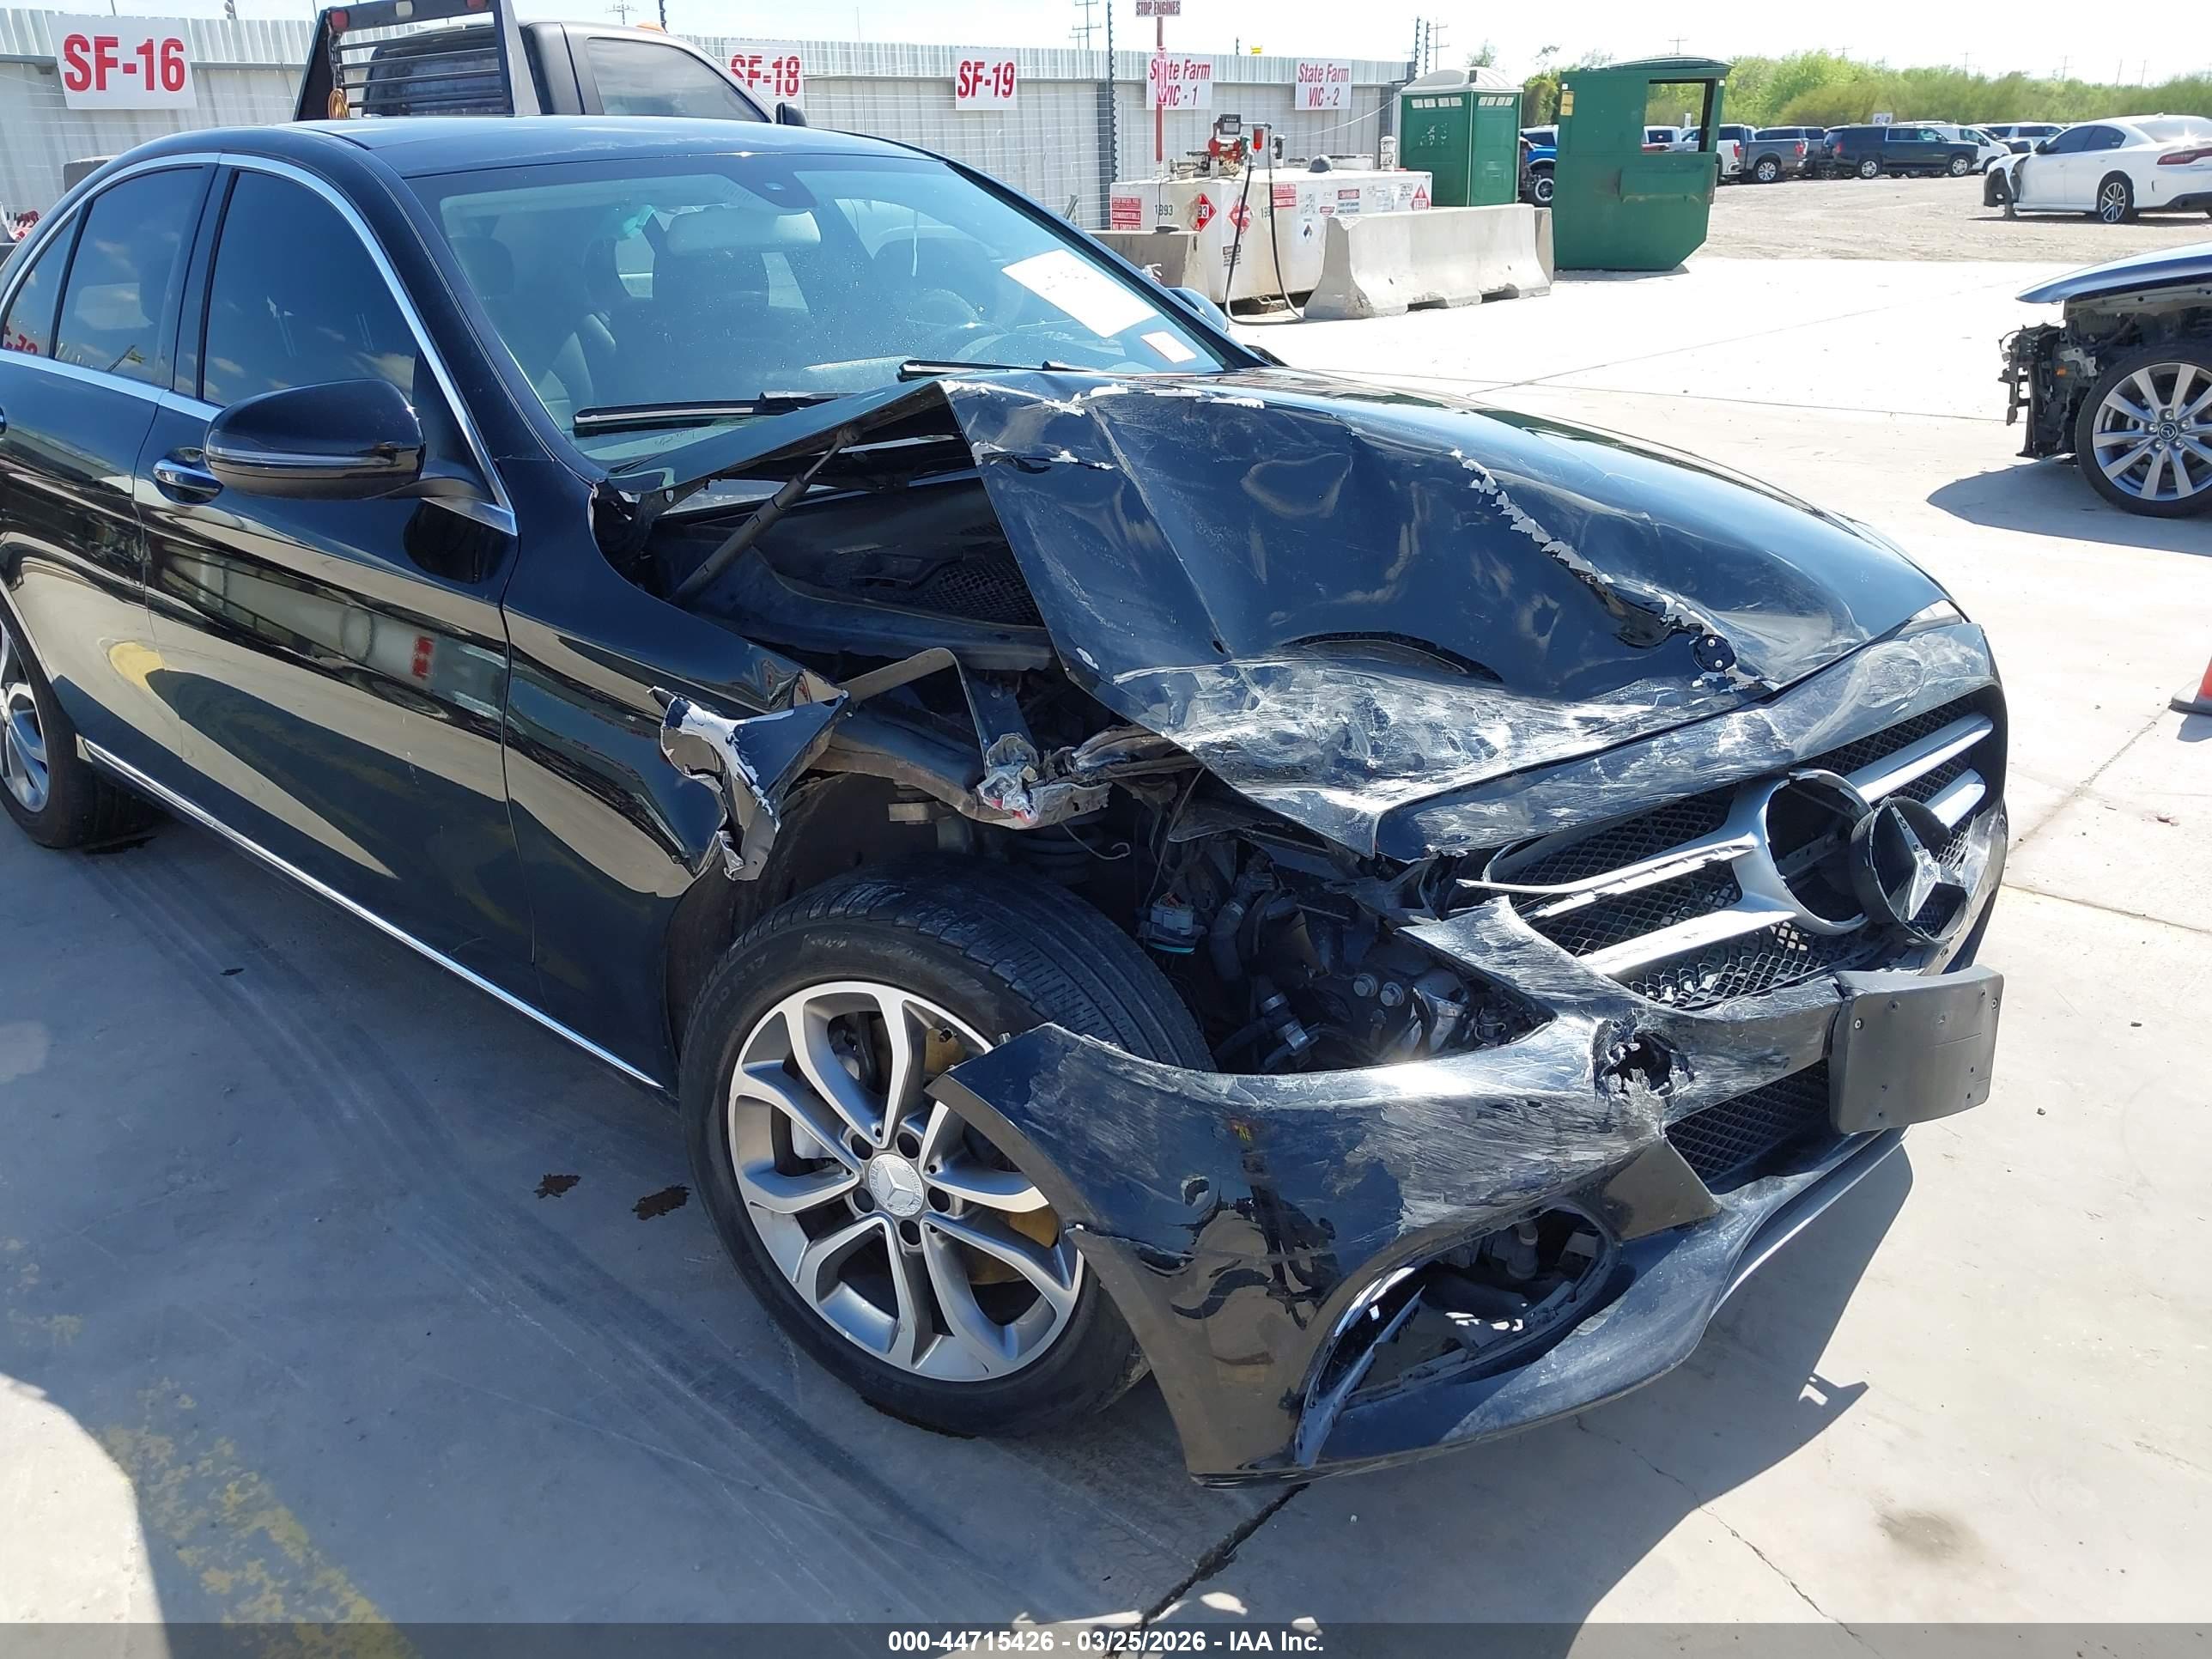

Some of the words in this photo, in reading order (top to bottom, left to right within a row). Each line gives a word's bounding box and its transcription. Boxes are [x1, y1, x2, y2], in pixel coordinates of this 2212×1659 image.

[1136, 2, 1152, 15] STOP
[1154, 1, 1181, 15] ENGINES
[64, 33, 185, 92] SF-16
[1149, 58, 1180, 81] Ste
[1182, 58, 1211, 80] Farm
[1297, 63, 1323, 82] State
[1326, 64, 1349, 82] Farm
[731, 54, 800, 97] SF-18
[957, 60, 1015, 98] SF-19
[1192, 84, 1199, 106] 1
[1309, 87, 1324, 106] VIC
[1332, 87, 1340, 106] 2
[1154, 204, 1174, 216] 1993
